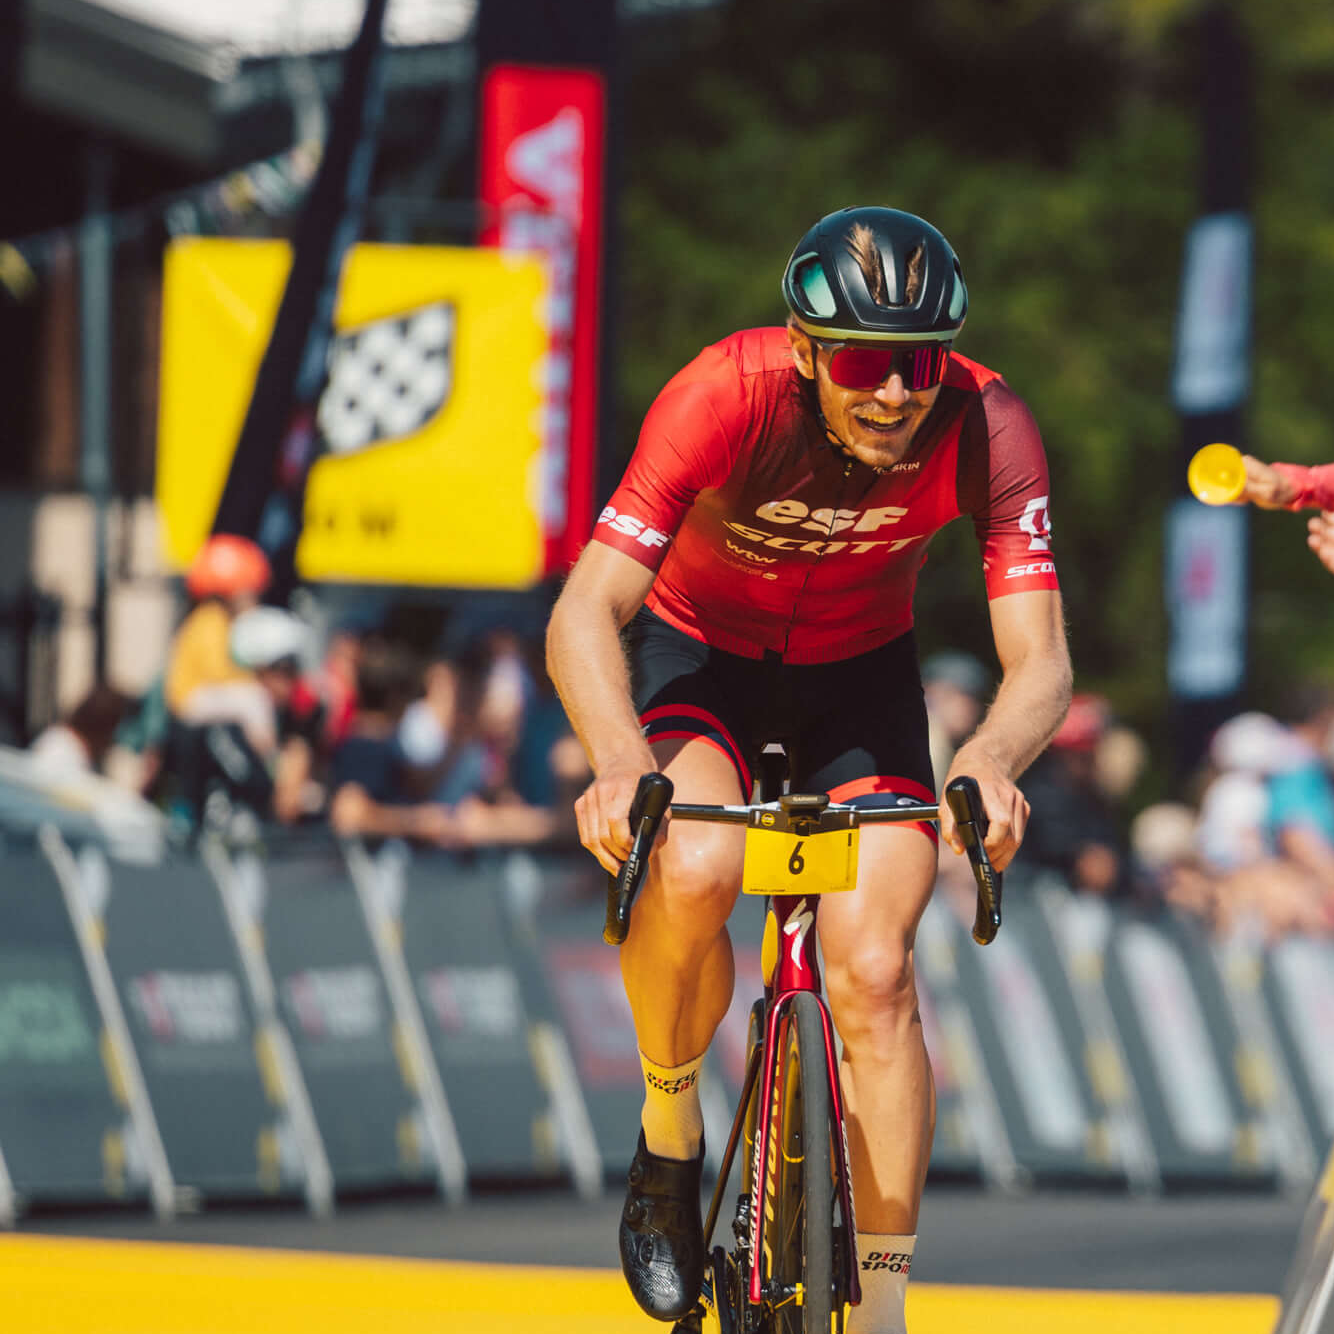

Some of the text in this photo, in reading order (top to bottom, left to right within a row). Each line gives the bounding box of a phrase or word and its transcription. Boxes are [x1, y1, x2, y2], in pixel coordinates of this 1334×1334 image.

[597, 506, 669, 548] esf
[755, 499, 909, 536] esf
[721, 519, 925, 556] SCOTT
[788, 841, 804, 875] 6
[861, 1260, 912, 1275] SPOR
